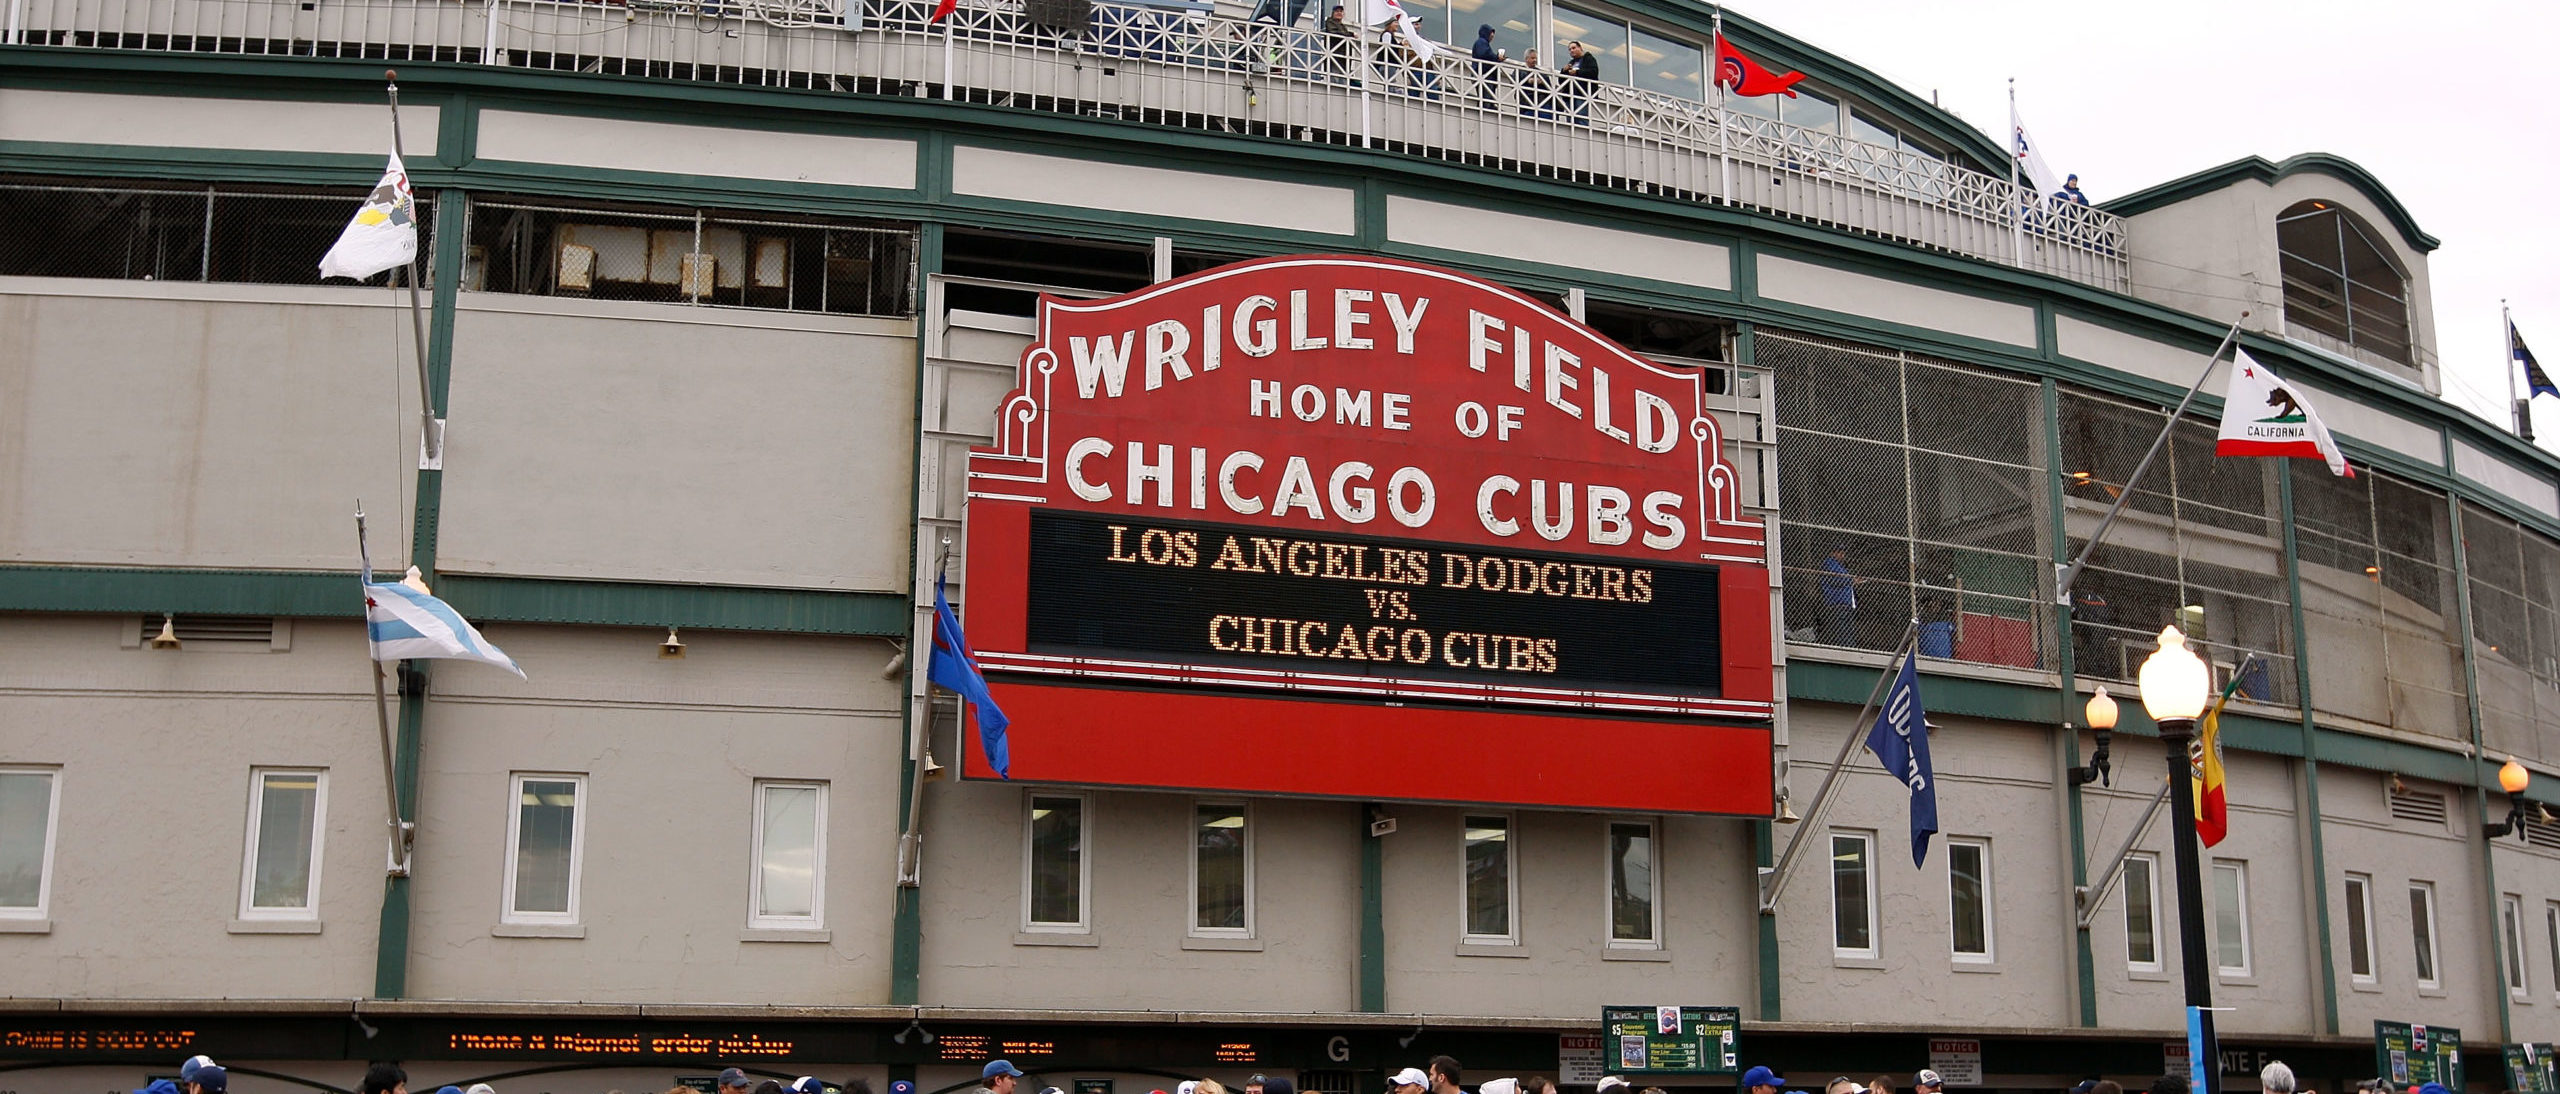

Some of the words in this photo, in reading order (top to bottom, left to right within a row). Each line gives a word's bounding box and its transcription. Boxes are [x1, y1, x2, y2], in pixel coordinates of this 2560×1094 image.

[1068, 288, 1431, 399] WRIGLEY
[1469, 308, 1680, 454] FIELD
[1250, 379, 1411, 431] HOME
[1455, 401, 1525, 441] OF
[2247, 425, 2305, 438] CALIFORNIA
[1065, 437, 1436, 528] CHICAGO
[1476, 474, 1686, 551] CUBS
[1107, 525, 1198, 568] LOS
[1210, 535, 1430, 587] ANGELES
[1441, 553, 1653, 603] DODGERS
[1363, 589, 1417, 621] VS.
[1209, 614, 1432, 665] CHICAGO
[1443, 631, 1558, 673] CUBS
[96, 1031, 148, 1048] SOLD
[153, 1031, 196, 1049] OUT
[1612, 1024, 1622, 1036] $5
[1695, 1024, 1705, 1036] $2
[1327, 1035, 1350, 1062] G
[1936, 1043, 1974, 1052] NOTICE
[2221, 1051, 2250, 1072] ATE
